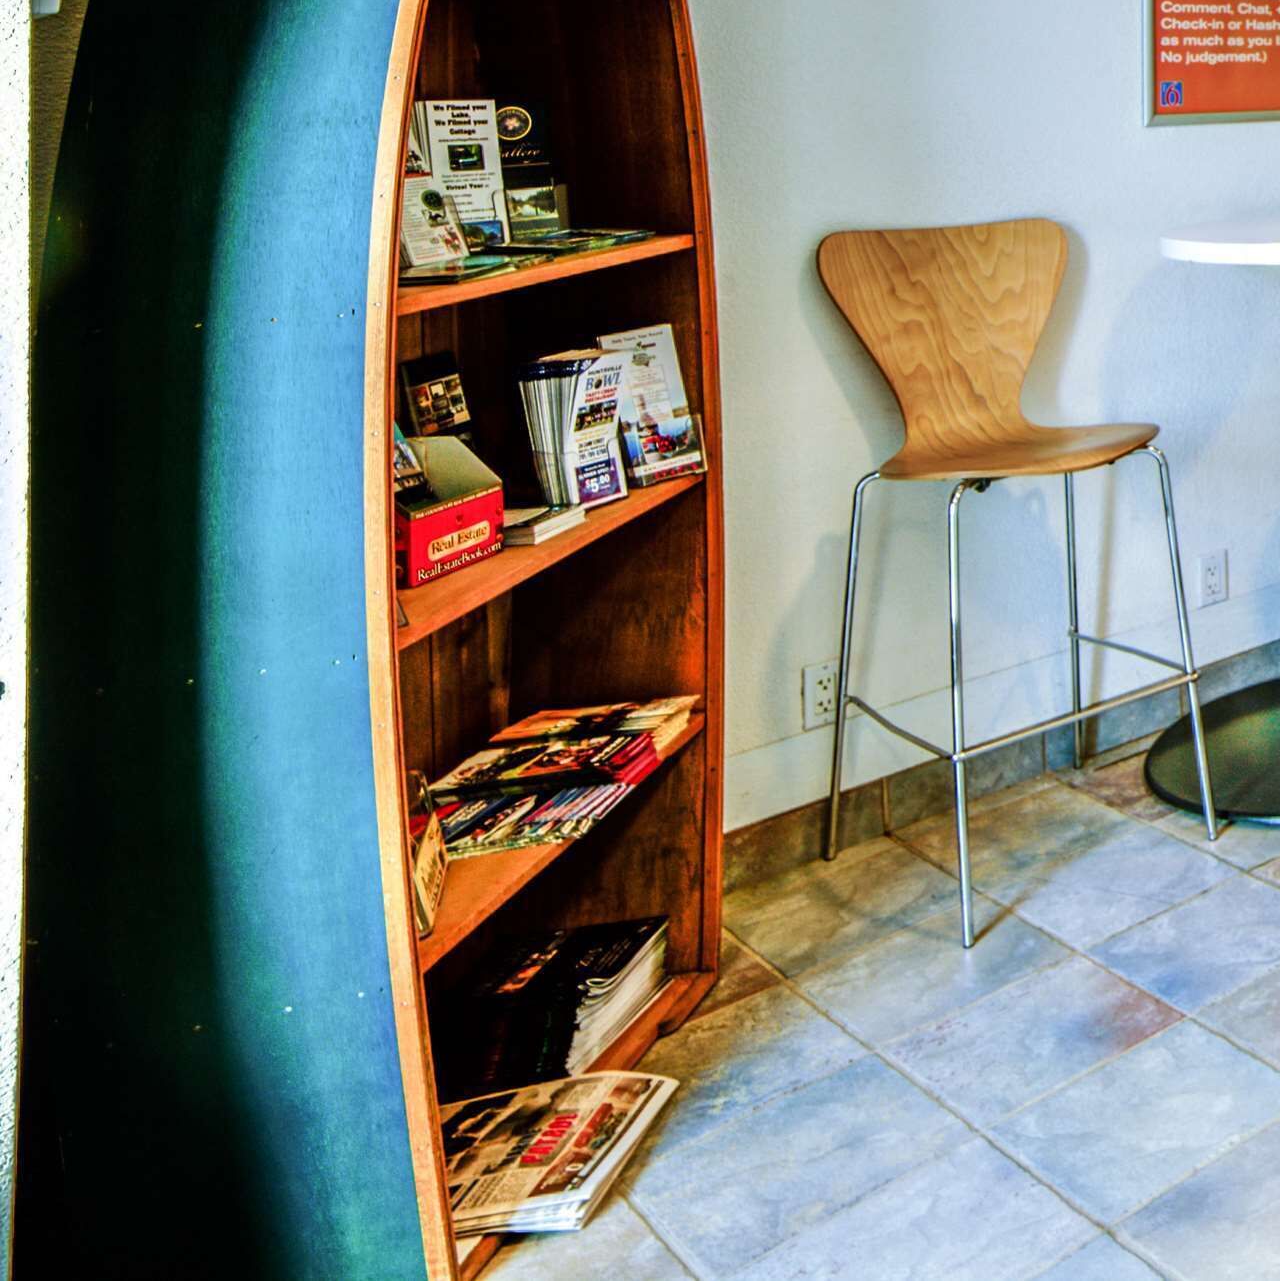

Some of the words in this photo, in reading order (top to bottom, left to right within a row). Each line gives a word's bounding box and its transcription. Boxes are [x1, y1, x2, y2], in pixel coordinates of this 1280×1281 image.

[1160, 1, 1234, 15] Comment,
[1237, 3, 1272, 16] Chat,
[1160, 18, 1224, 30] Check-in
[1228, 21, 1243, 30] or
[1160, 37, 1179, 47] as
[1183, 35, 1224, 46] much
[1227, 37, 1245, 46] as
[1248, 37, 1272, 49] you
[1160, 51, 1182, 63] No
[1185, 51, 1268, 66] judgement.)
[431, 535, 456, 555] Real
[457, 526, 488, 546] Estate
[417, 541, 502, 582] RealEstateBook.com
